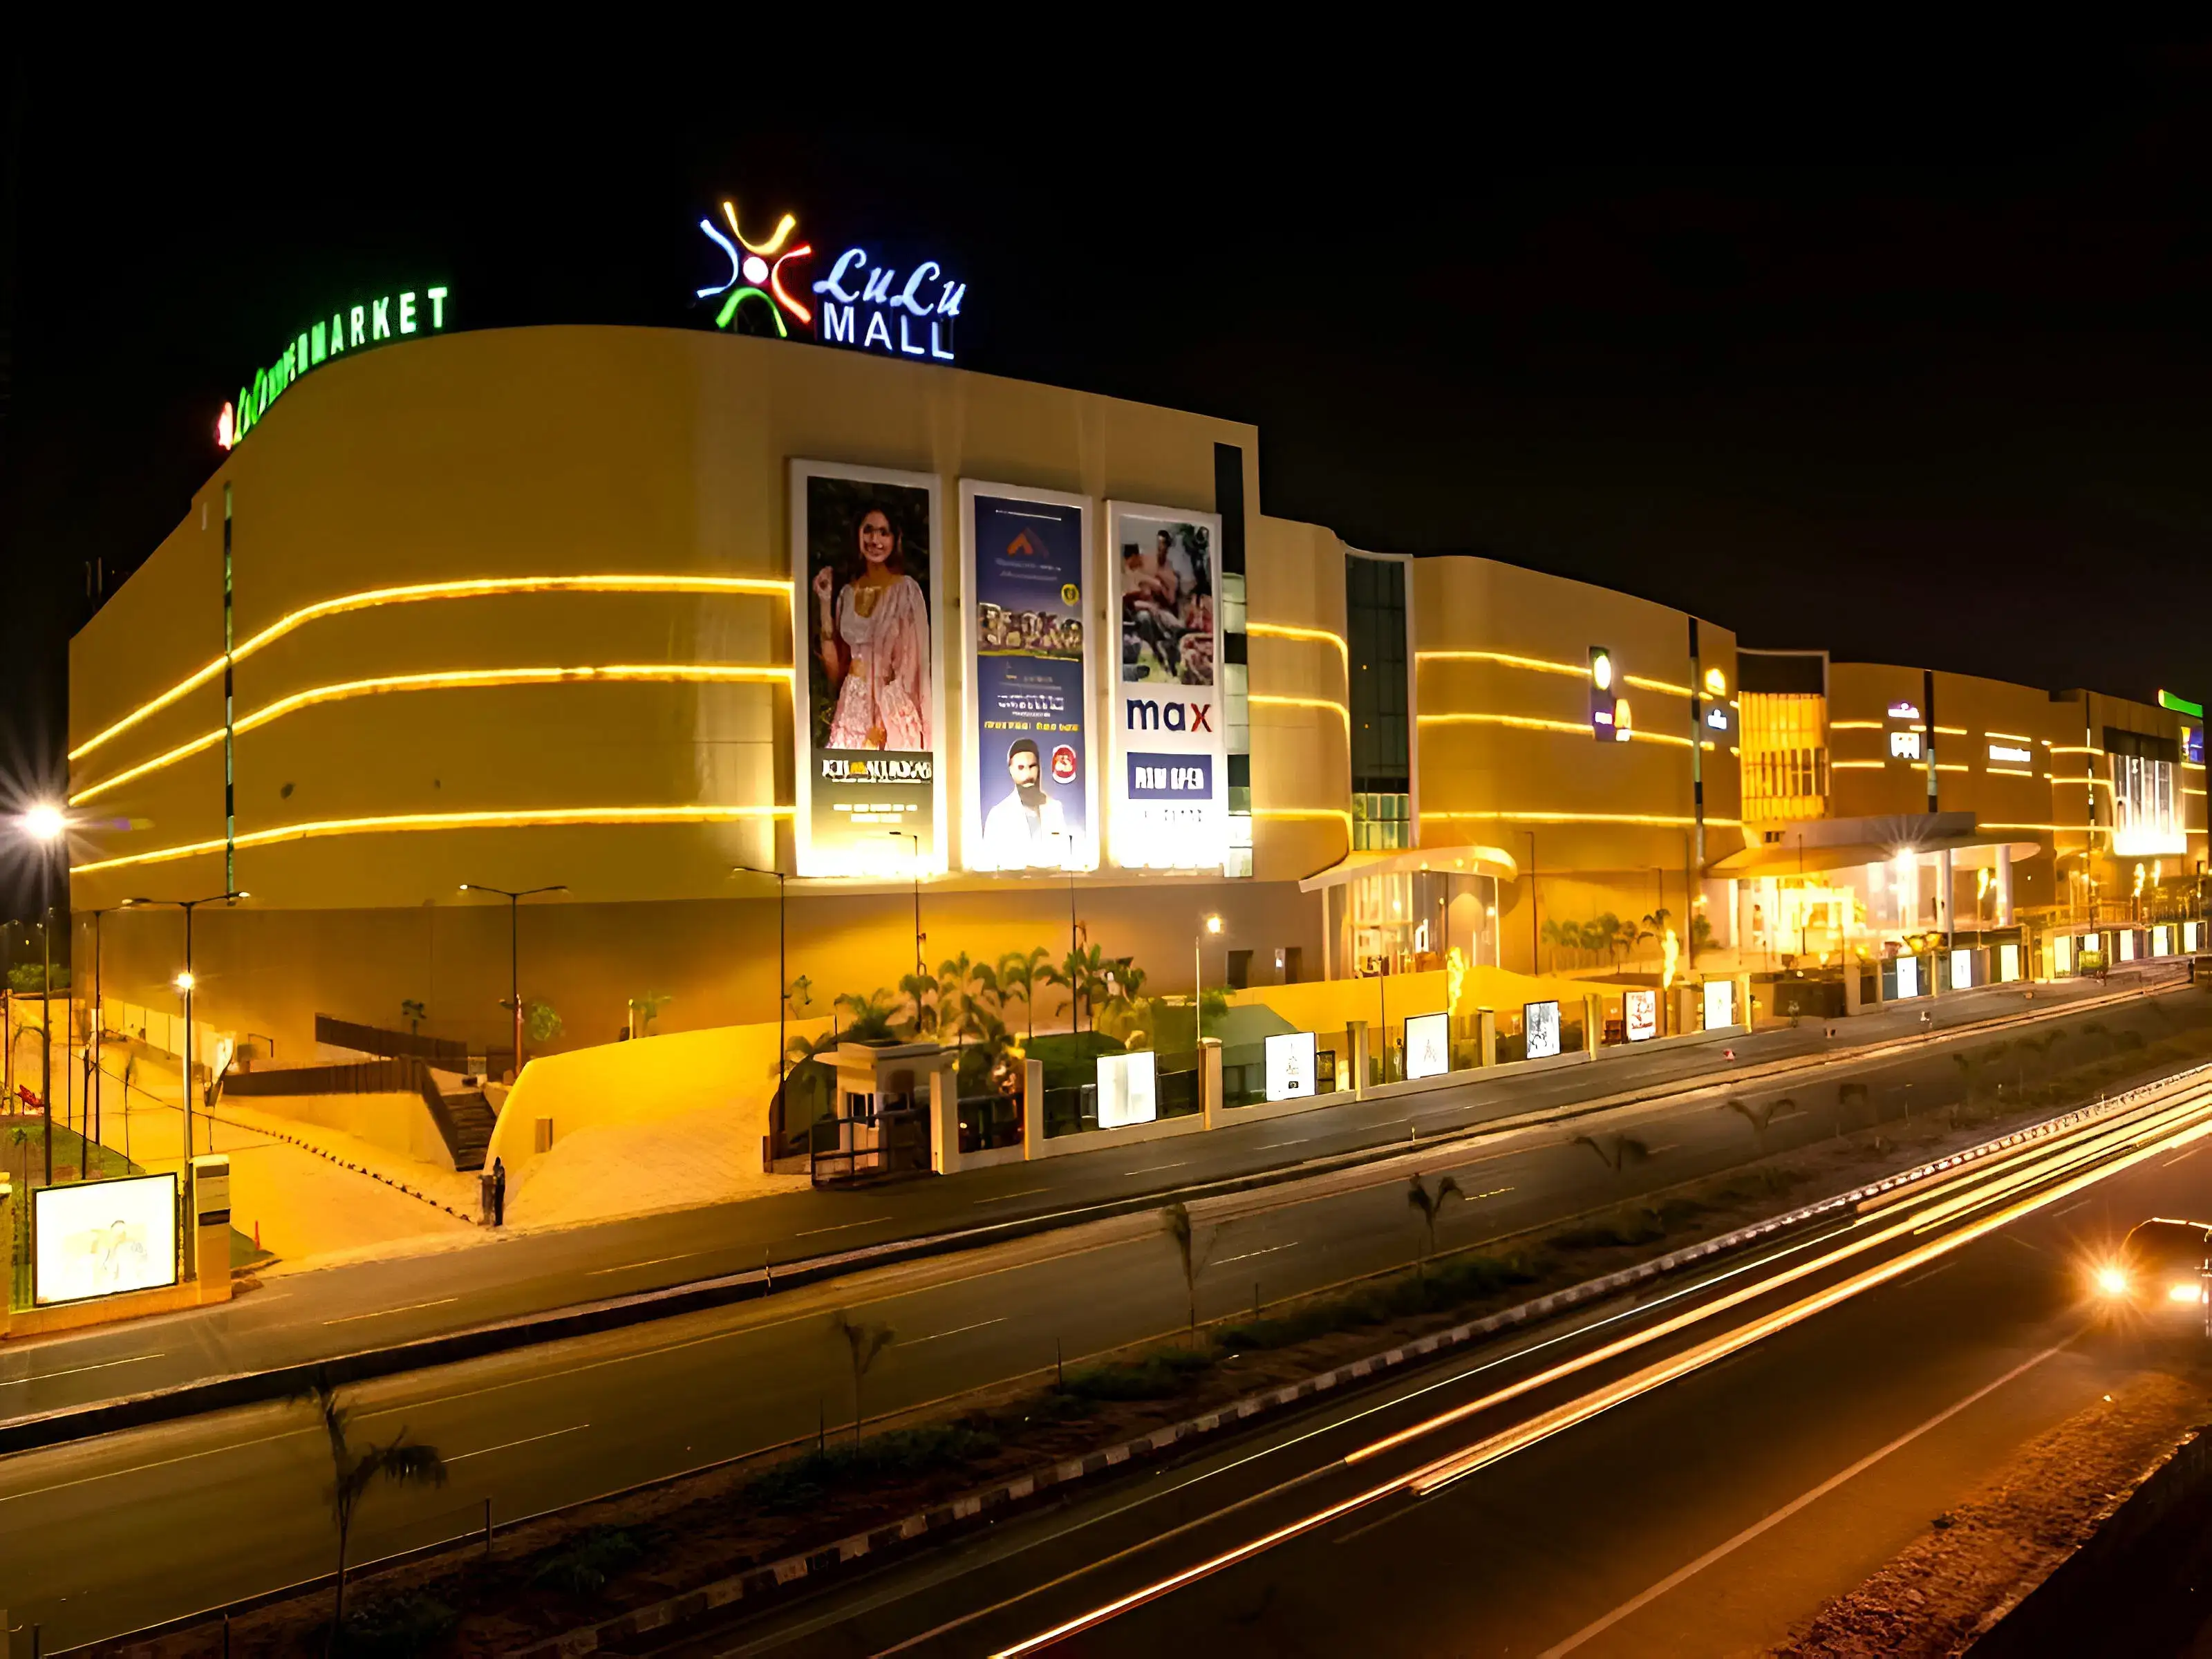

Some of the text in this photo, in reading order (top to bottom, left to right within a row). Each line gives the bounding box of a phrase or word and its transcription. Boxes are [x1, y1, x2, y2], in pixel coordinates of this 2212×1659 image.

[812, 247, 966, 317] LuLu
[823, 302, 955, 360] MALL
[1127, 699, 1212, 733] max
